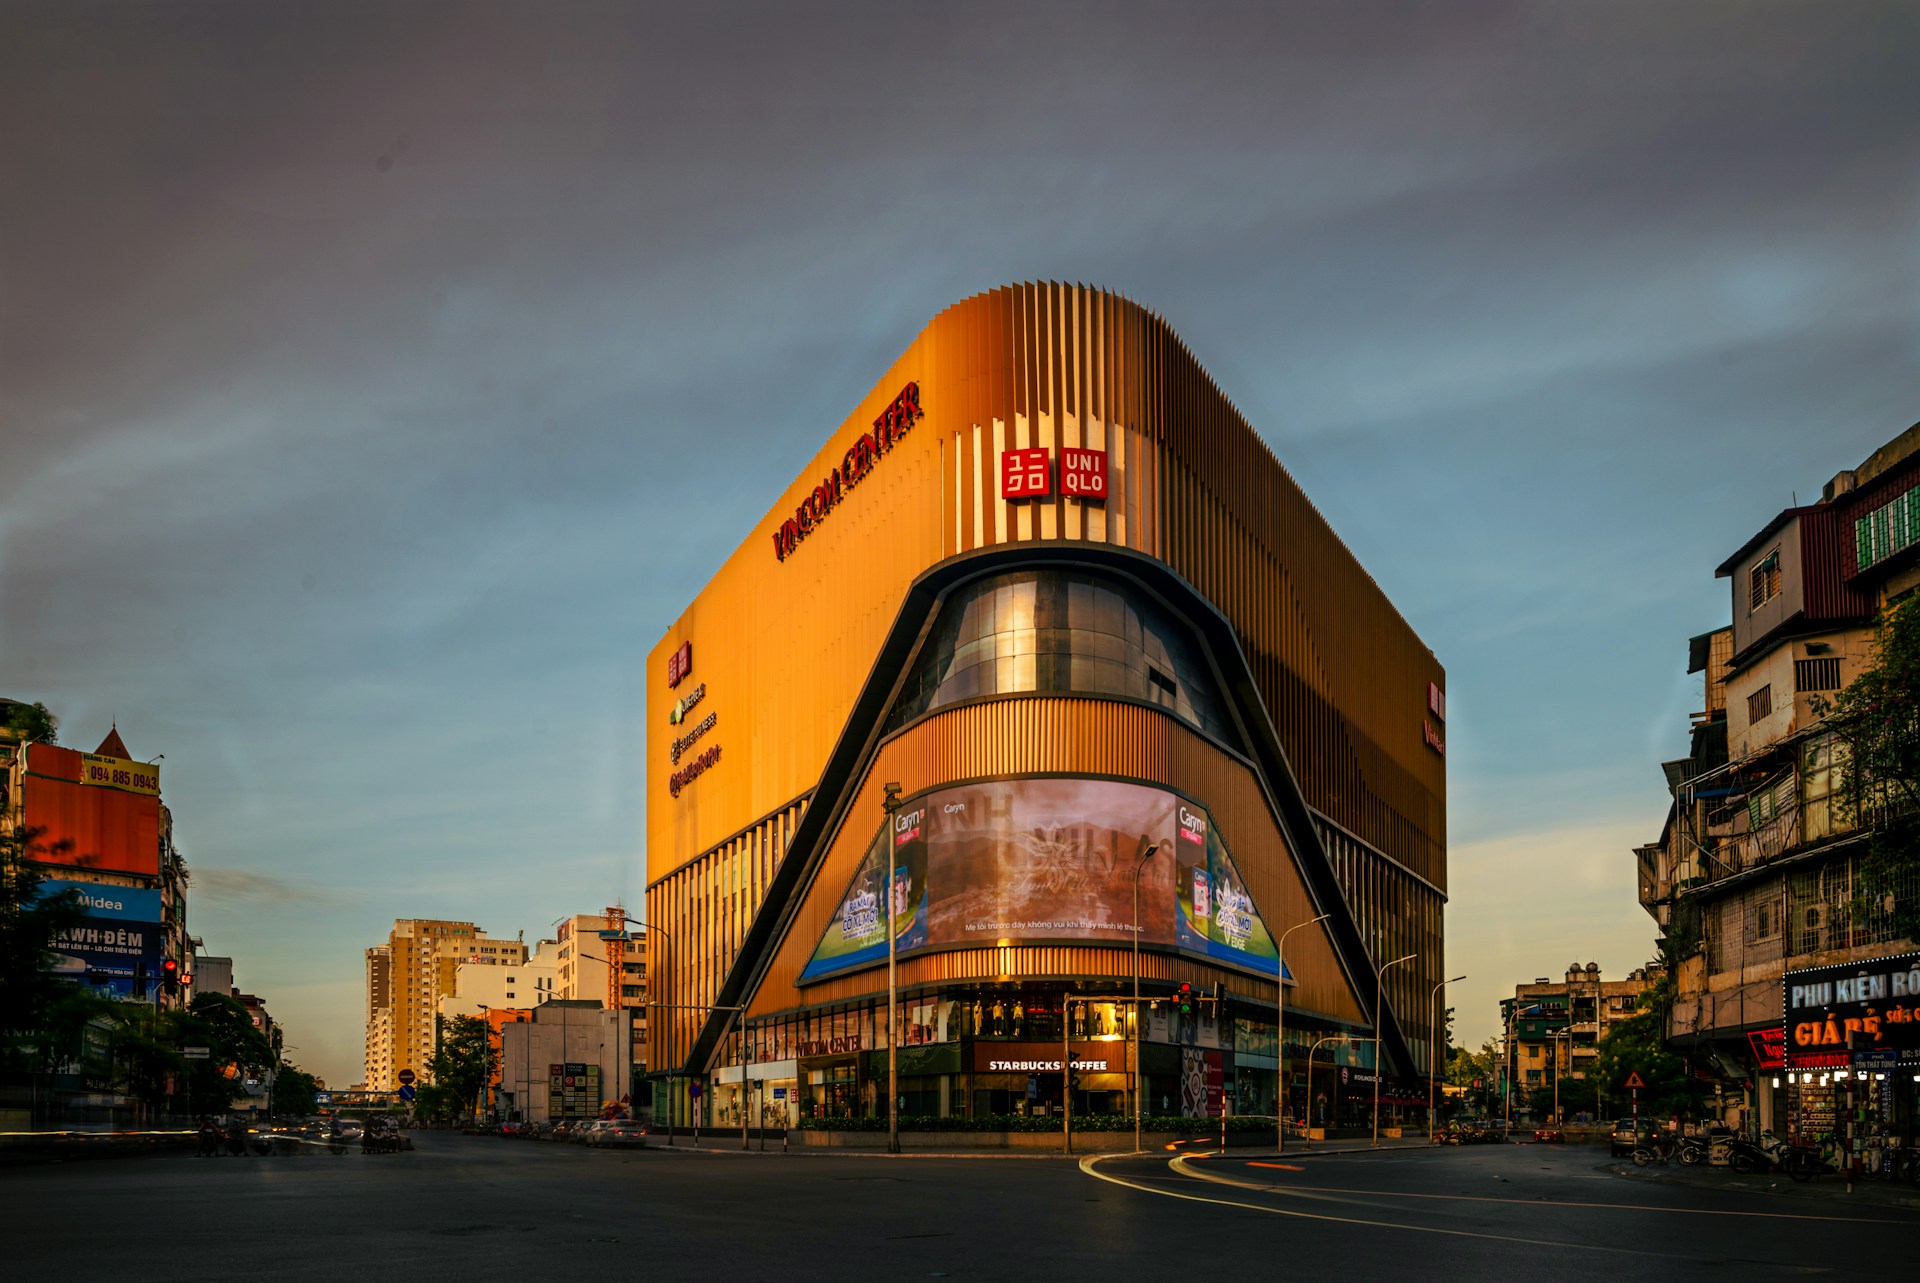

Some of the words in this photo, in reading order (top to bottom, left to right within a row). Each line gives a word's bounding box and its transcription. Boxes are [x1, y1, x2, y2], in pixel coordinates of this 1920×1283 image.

[772, 468, 841, 561] VINCOM
[840, 381, 921, 486] CENTER
[1066, 453, 1099, 472] UNI
[1066, 473, 1102, 492] QLO
[91, 766, 109, 781] 094
[112, 769, 130, 786] 885
[133, 773, 157, 790] 0943
[944, 803, 965, 814] Caryn
[895, 810, 919, 833] Caryn
[1179, 806, 1203, 834] Caryn
[76, 895, 123, 910] Midea
[965, 924, 976, 932] Mẹ
[1066, 920, 1079, 928] khi
[103, 928, 143, 947] ĐÊM
[1836, 970, 1887, 1007] KIỆN
[1795, 1013, 1842, 1046] GIÁ
[989, 1061, 1061, 1070] STARBUCKS
[1062, 1061, 1107, 1070] OFFEE
